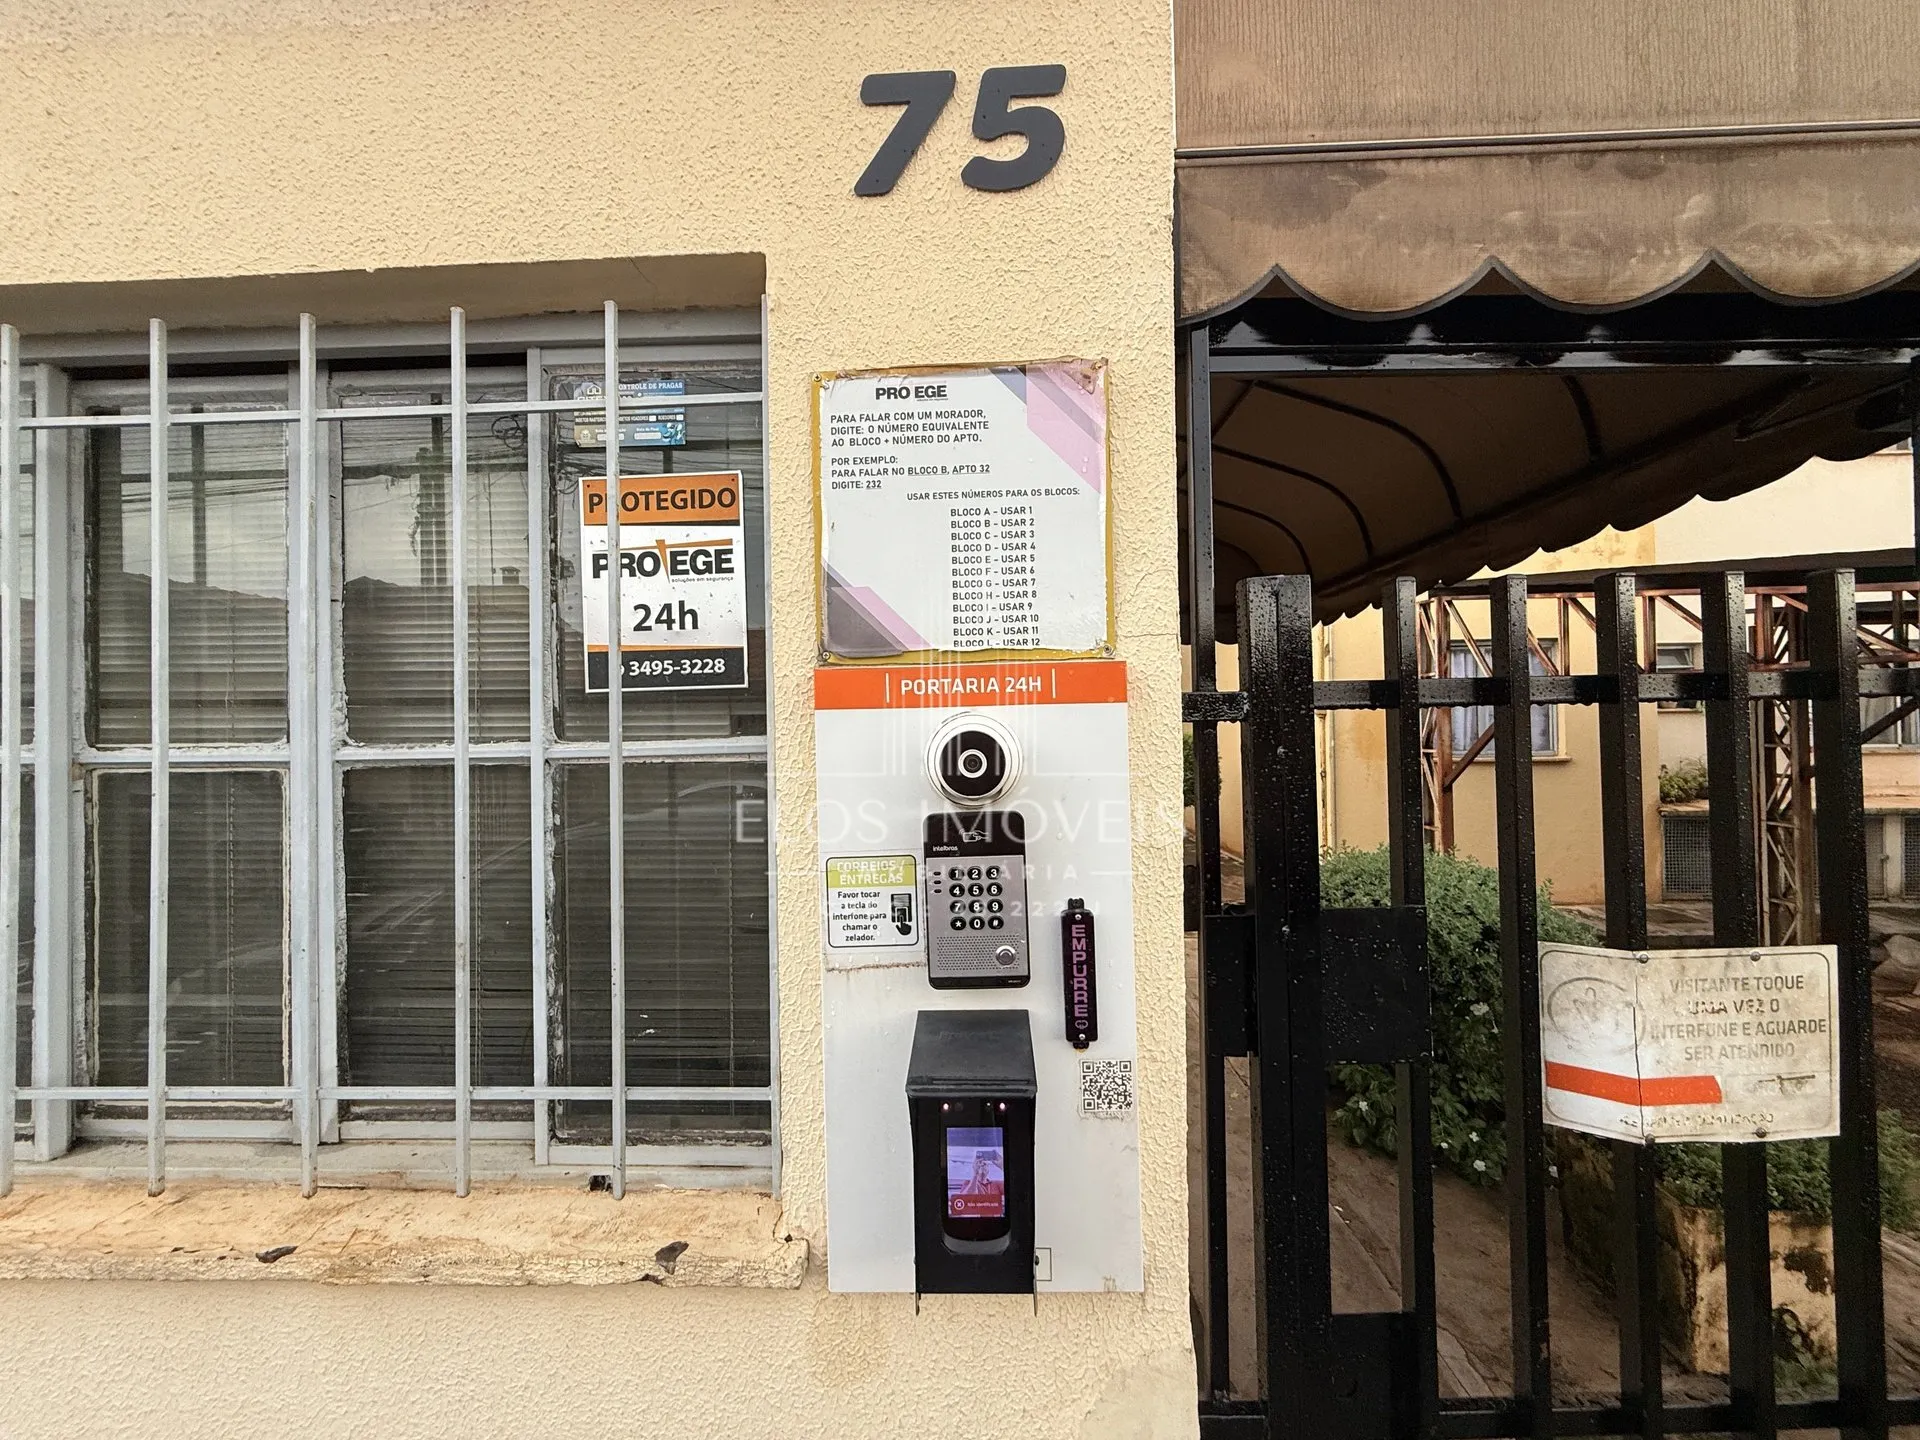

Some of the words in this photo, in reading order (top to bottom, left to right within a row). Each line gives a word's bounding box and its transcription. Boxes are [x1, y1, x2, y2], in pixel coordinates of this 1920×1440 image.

[854, 64, 1066, 197] 75
[831, 415, 856, 423] PARA
[859, 413, 890, 422] FALAR
[894, 412, 914, 421] COM
[918, 411, 932, 420] UM
[935, 410, 986, 419] MORADOR,
[831, 426, 864, 435] DIGITE:
[868, 425, 874, 433] O
[878, 422, 919, 433] NÚMERO
[922, 421, 989, 432] EQUIVALENTE
[832, 439, 844, 447] AO
[850, 437, 881, 446] BLOCO
[893, 434, 934, 444] NÚMERO
[937, 435, 950, 443] DO
[953, 433, 982, 442] APTO.
[853, 456, 898, 464] EXEMPLO:
[832, 469, 855, 477] PARA
[859, 468, 888, 476] FALAR
[892, 467, 904, 475] NO
[908, 466, 938, 474] BLOCO
[952, 465, 976, 473] APTO
[979, 464, 990, 473] 32
[832, 481, 863, 489] DIGITE:
[866, 480, 881, 488] 232
[962, 489, 1003, 498] NÚMEROS
[1045, 488, 1080, 496] BLOCOS:
[589, 487, 735, 513] POTEGIDO
[951, 508, 981, 516] BLOCO
[1001, 507, 1026, 515] USAR
[1029, 506, 1032, 514] 1
[1001, 519, 1026, 527] USAR
[1030, 518, 1034, 526] 2
[1001, 531, 1026, 539] USAR
[1029, 530, 1034, 538] 3
[1002, 543, 1027, 551] USAR
[1030, 542, 1035, 550] 4
[1001, 555, 1027, 563] USAR
[1030, 554, 1035, 562] 5
[1001, 567, 1027, 575] USAR
[1030, 566, 1035, 574] 6
[1003, 579, 1028, 587] USAR
[1031, 578, 1036, 586] 7
[1003, 591, 1028, 599] USAR
[953, 604, 983, 612] BLOCO
[1000, 603, 1025, 611] USAR
[633, 600, 699, 631] 24h
[953, 616, 983, 624] BLOCO
[1002, 615, 1027, 623] USAR
[1030, 614, 1039, 622] 10
[954, 628, 984, 636] BLOCO
[1004, 627, 1029, 635] USAR
[1032, 626, 1038, 634] 11
[1032, 638, 1040, 646] 12
[629, 658, 726, 676] 3495-3228
[901, 678, 999, 695] PORTARIA
[1006, 676, 1041, 692] 24H
[840, 872, 903, 885] ENTREGAS
[955, 870, 958, 878] 1
[972, 870, 978, 878] 2
[991, 869, 997, 877] 3
[954, 887, 960, 895] 4
[973, 886, 979, 894] 5
[991, 886, 997, 894] 6
[955, 904, 961, 912] 7
[974, 902, 979, 910] 8
[992, 902, 998, 910] 9
[870, 913, 886, 921] para
[974, 920, 980, 928] 0
[1071, 924, 1089, 1018] EMPURRE
[1753, 975, 1804, 990] TOQUE
[1770, 999, 1779, 1012] O
[1742, 1022, 1750, 1035] E
[1755, 1019, 1827, 1035] AGUARDE
[1685, 1047, 1713, 1061] SER
[1718, 1043, 1795, 1060] ATENDIDO
